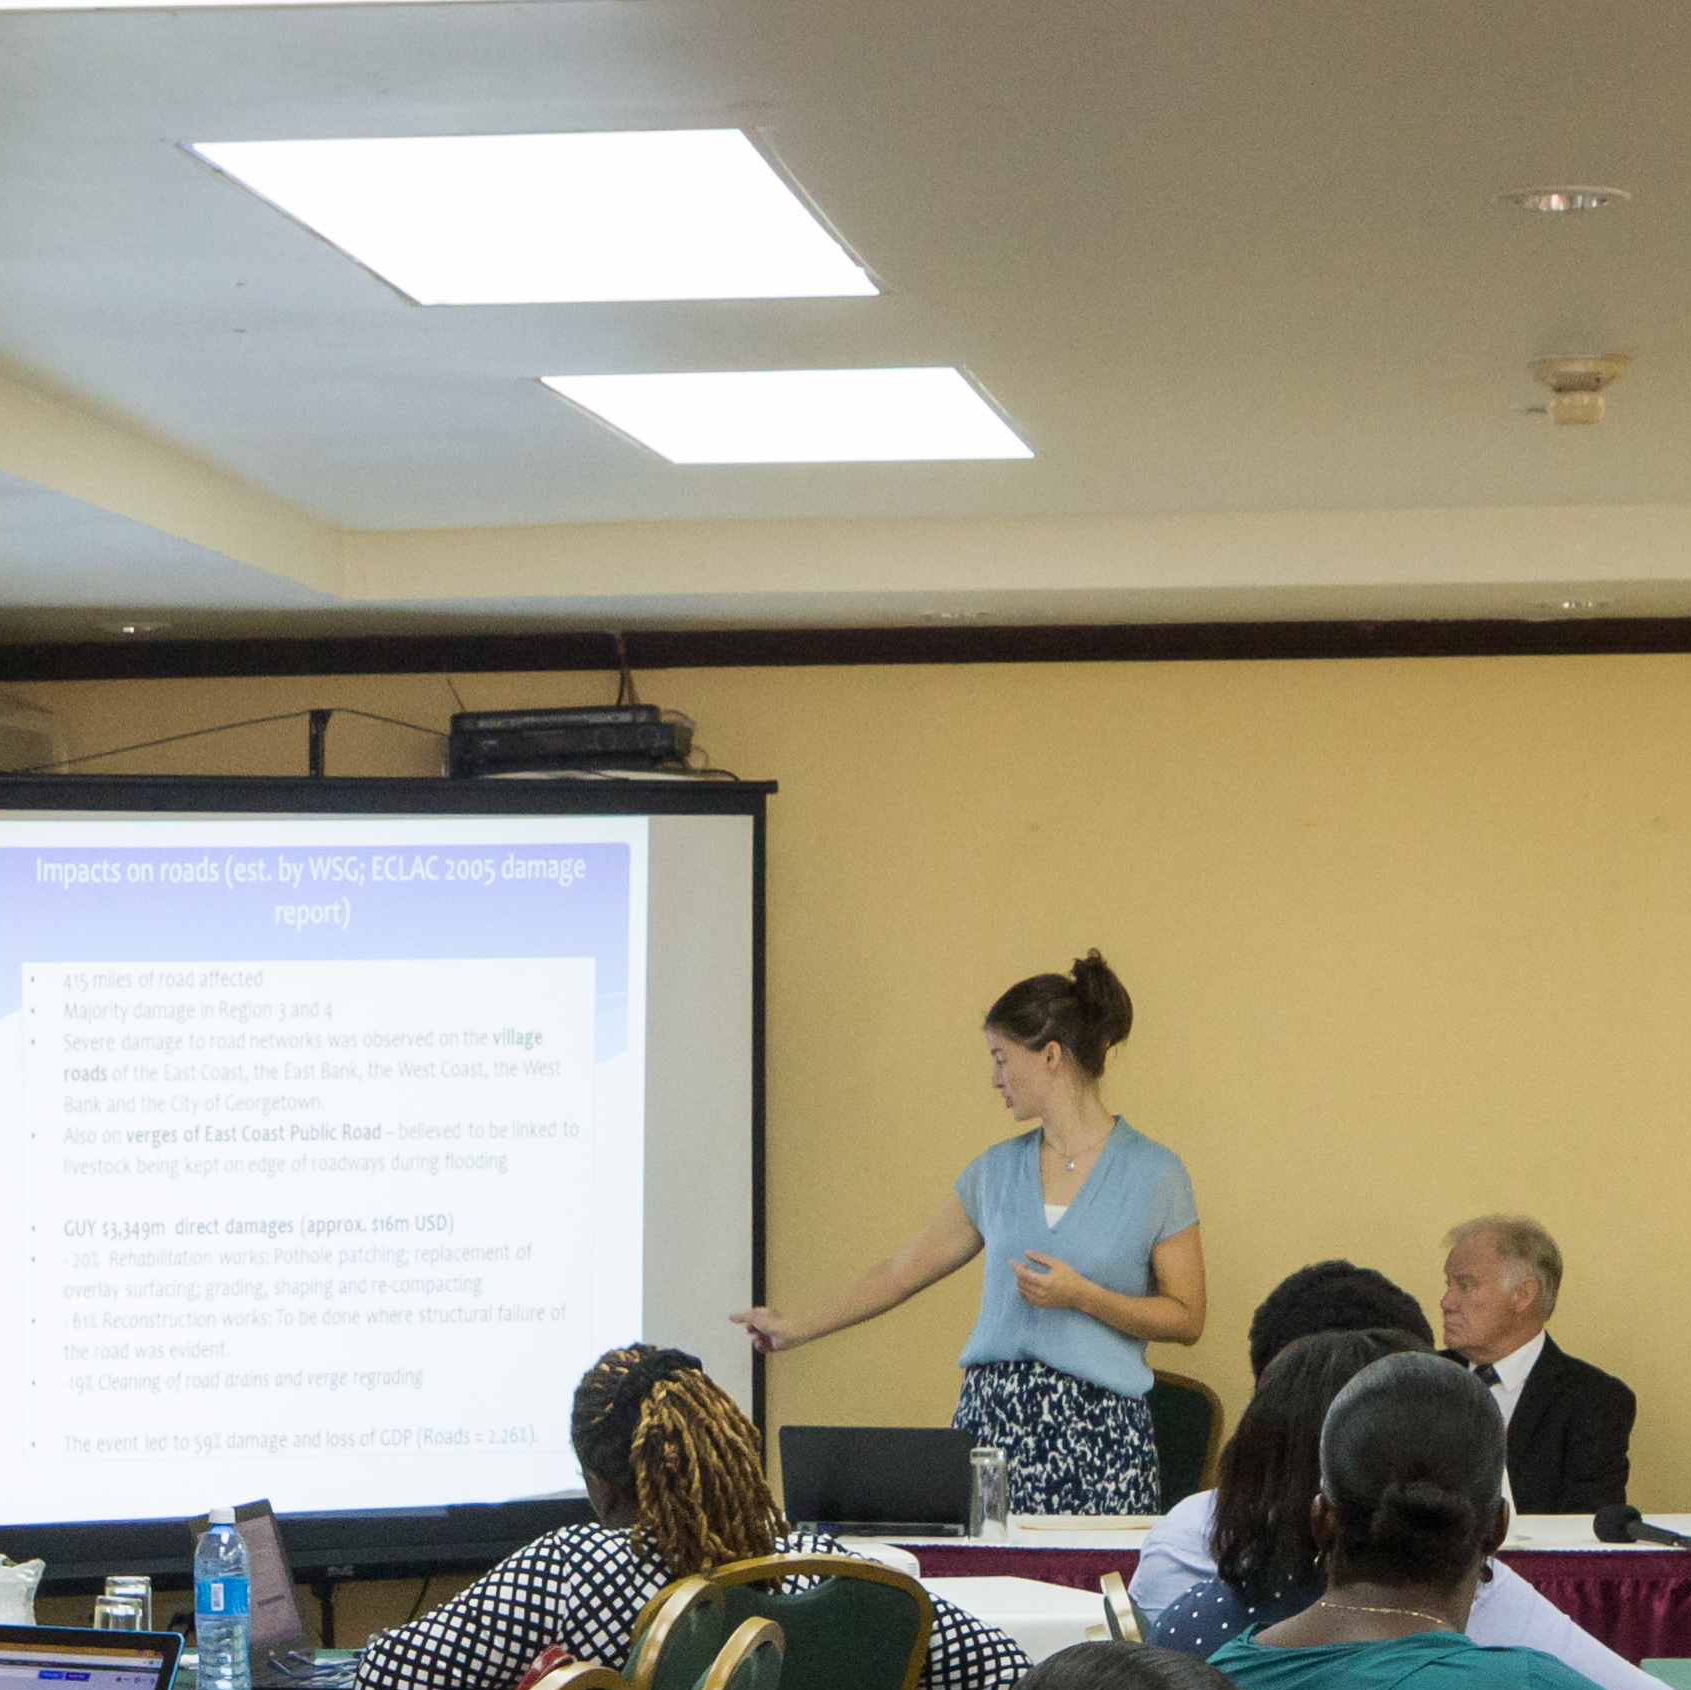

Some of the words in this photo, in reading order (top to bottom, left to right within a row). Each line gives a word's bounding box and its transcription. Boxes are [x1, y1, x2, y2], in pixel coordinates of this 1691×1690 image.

[36, 856, 121, 889] Impacts
[126, 862, 154, 882] on
[160, 854, 219, 882] roads
[278, 854, 304, 888] by
[372, 855, 438, 880] ECLAC
[445, 859, 495, 884] 2005
[502, 852, 586, 886] damage
[275, 896, 351, 930] report)
[63, 973, 89, 991] 415
[92, 970, 133, 987] miles
[138, 969, 155, 987] of
[158, 970, 195, 986] road
[199, 968, 263, 986] affected
[64, 1001, 129, 1023] Majority
[132, 1001, 196, 1023] damage
[200, 1001, 215, 1016] in
[218, 1000, 273, 1023] Region
[278, 1003, 287, 1021] 3
[290, 1000, 319, 1016] and
[324, 1002, 333, 1019] 4
[64, 1033, 115, 1049] Severe
[121, 1033, 184, 1054] damage
[188, 1033, 206, 1048] to
[210, 1032, 246, 1048] road
[250, 1032, 322, 1047] networks
[328, 1034, 358, 1046] was
[363, 1030, 434, 1046] observed
[439, 1032, 459, 1045] on
[463, 1029, 489, 1045] the
[492, 1027, 544, 1050] village
[63, 1063, 108, 1081] roads
[112, 1063, 129, 1080] of
[133, 1064, 159, 1080] the
[164, 1063, 196, 1080] East
[253, 1062, 279, 1079] the
[284, 1062, 316, 1078] East
[368, 1061, 393, 1077] the
[397, 1061, 436, 1077] West
[493, 1060, 519, 1075] the
[522, 1059, 561, 1075] West
[64, 1095, 102, 1112] Bank
[106, 1095, 136, 1111] and
[140, 1094, 167, 1111] the
[170, 1094, 199, 1115] City
[204, 1093, 221, 1110] of
[64, 1127, 97, 1142] Also
[102, 1130, 121, 1142] on
[126, 1129, 178, 1147] verges
[183, 1124, 201, 1141] of
[204, 1125, 238, 1141] East
[241, 1124, 285, 1141] Coast
[290, 1122, 337, 1139] Public
[342, 1123, 382, 1139] Road
[399, 1123, 461, 1138] believed
[468, 1123, 485, 1137] to
[489, 1122, 508, 1137] be
[512, 1121, 557, 1136] linked
[563, 1121, 580, 1136] to
[63, 1157, 132, 1174] livestock
[136, 1156, 180, 1178] being
[184, 1156, 220, 1176] kept
[224, 1159, 244, 1172] on
[247, 1156, 286, 1177] edge
[291, 1153, 308, 1170] of
[311, 1154, 386, 1174] roadways
[390, 1153, 440, 1175] during
[444, 1151, 509, 1173] flooding
[63, 1219, 97, 1235] GUY
[102, 1221, 166, 1239] $3,349m
[174, 1217, 220, 1233] direct
[225, 1217, 295, 1238] damages
[372, 1215, 410, 1231] $16m
[415, 1213, 454, 1234] USD)
[108, 1248, 213, 1265] Rehabilitation
[274, 1246, 333, 1263] Pothole
[414, 1244, 510, 1264] replacement
[516, 1242, 533, 1259] of
[63, 1281, 120, 1301] overlay
[274, 1278, 334, 1299] shaping
[338, 1277, 367, 1293] and
[371, 1275, 483, 1296] re-compacting
[102, 1310, 217, 1327] Reconstruction
[276, 1308, 294, 1324] To
[298, 1308, 318, 1324] be
[321, 1308, 361, 1323] done
[366, 1306, 414, 1322] where
[418, 1305, 493, 1322] structural
[497, 1303, 546, 1320] failure
[550, 1302, 567, 1320] of
[63, 1343, 89, 1359] the
[94, 1342, 130, 1358] road
[134, 1344, 165, 1357] was
[98, 1372, 161, 1394] Cleaning
[166, 1371, 183, 1391] of
[185, 1371, 221, 1387] road
[224, 1370, 270, 1386] drains
[274, 1369, 303, 1385] and
[307, 1371, 348, 1390] verge
[353, 1367, 424, 1389] regrading
[64, 1434, 92, 1451] The
[96, 1435, 139, 1450] event
[145, 1434, 168, 1450] led
[172, 1434, 190, 1449] to
[226, 1431, 288, 1453] damage
[292, 1430, 321, 1446] and
[326, 1430, 357, 1446] loss
[359, 1428, 376, 1446] of
[380, 1428, 413, 1445] GDP
[416, 1426, 471, 1449] (Roads
